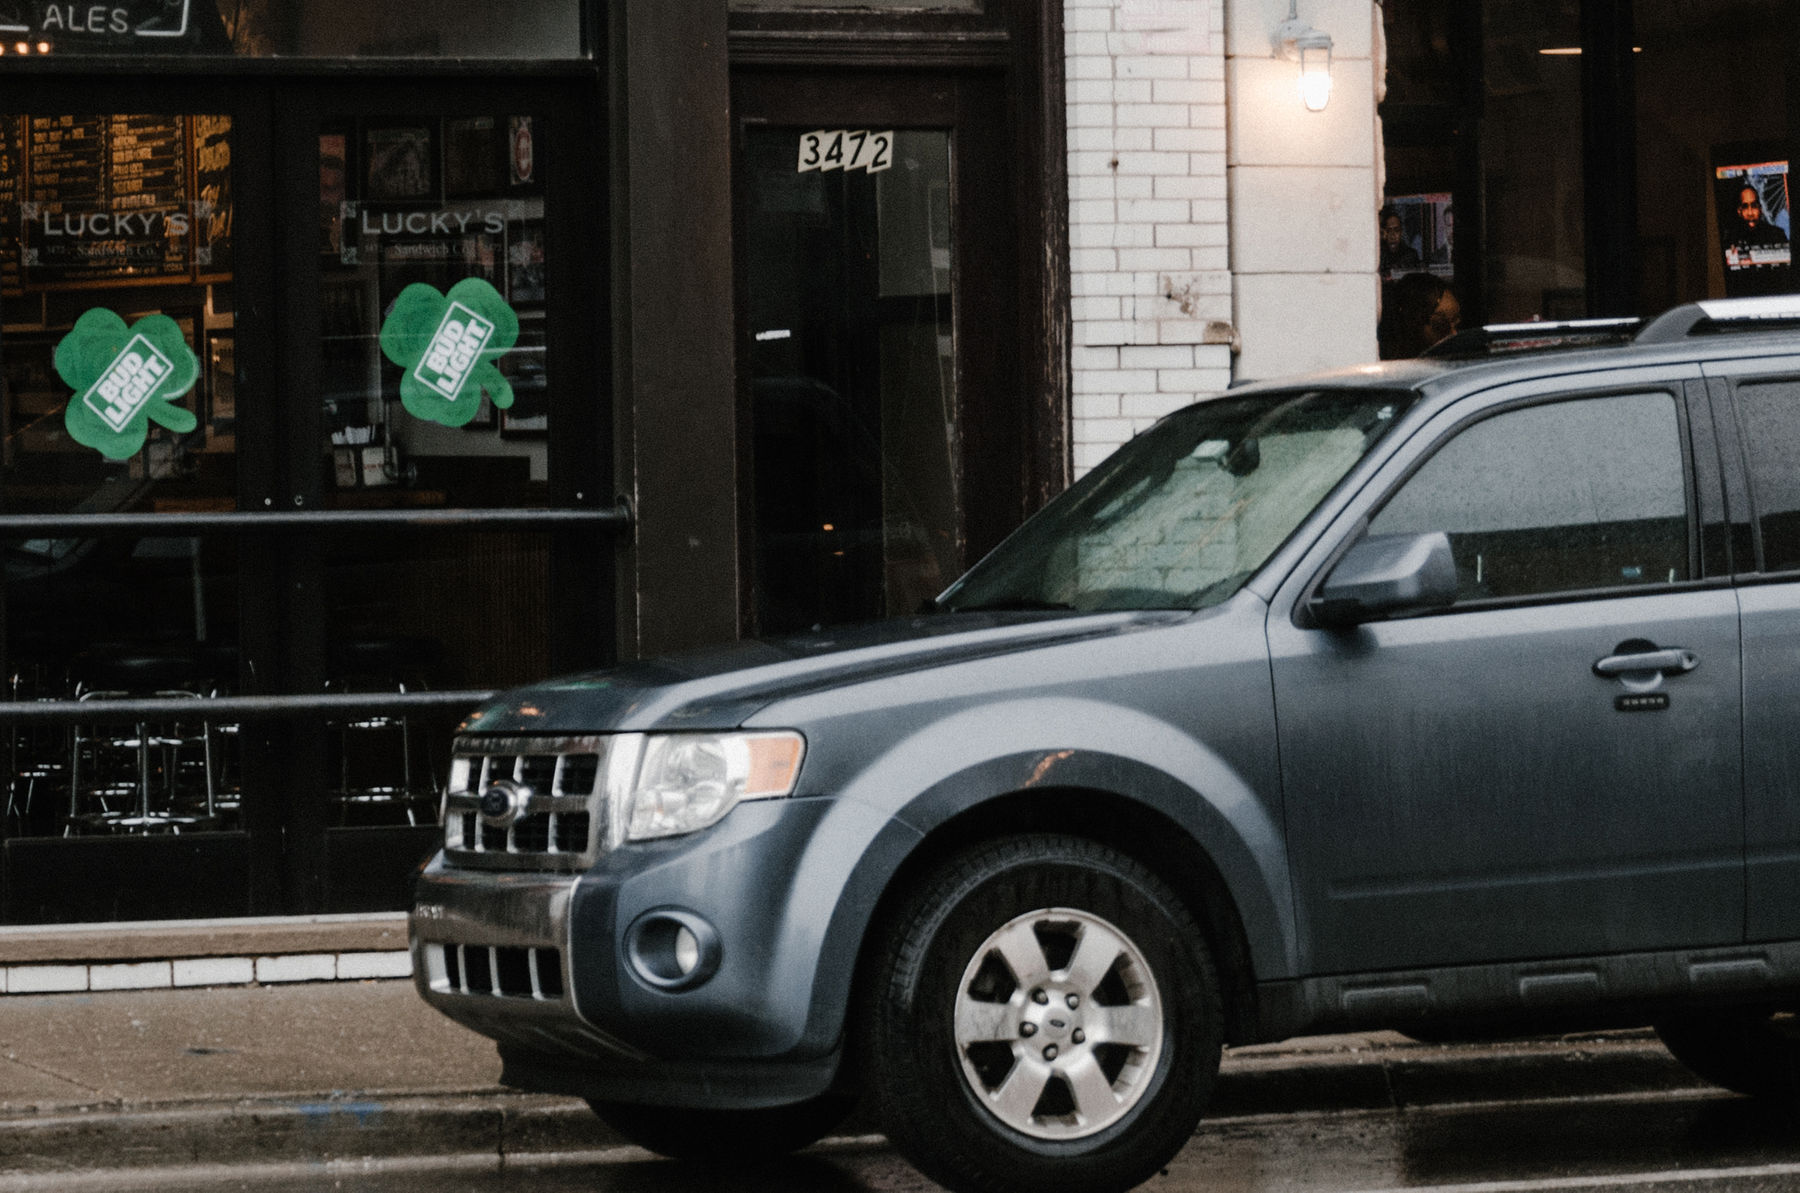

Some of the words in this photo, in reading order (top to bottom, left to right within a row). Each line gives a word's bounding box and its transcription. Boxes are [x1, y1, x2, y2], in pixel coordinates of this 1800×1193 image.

[42, 4, 129, 33] ALES
[804, 132, 888, 168] 3472
[43, 210, 189, 236] LUCKY'S
[362, 210, 504, 234] LUCKY'S
[425, 319, 466, 375] BUD
[436, 318, 488, 394] LIGHT
[96, 352, 143, 403] BUD
[104, 354, 166, 425] LIGHT
